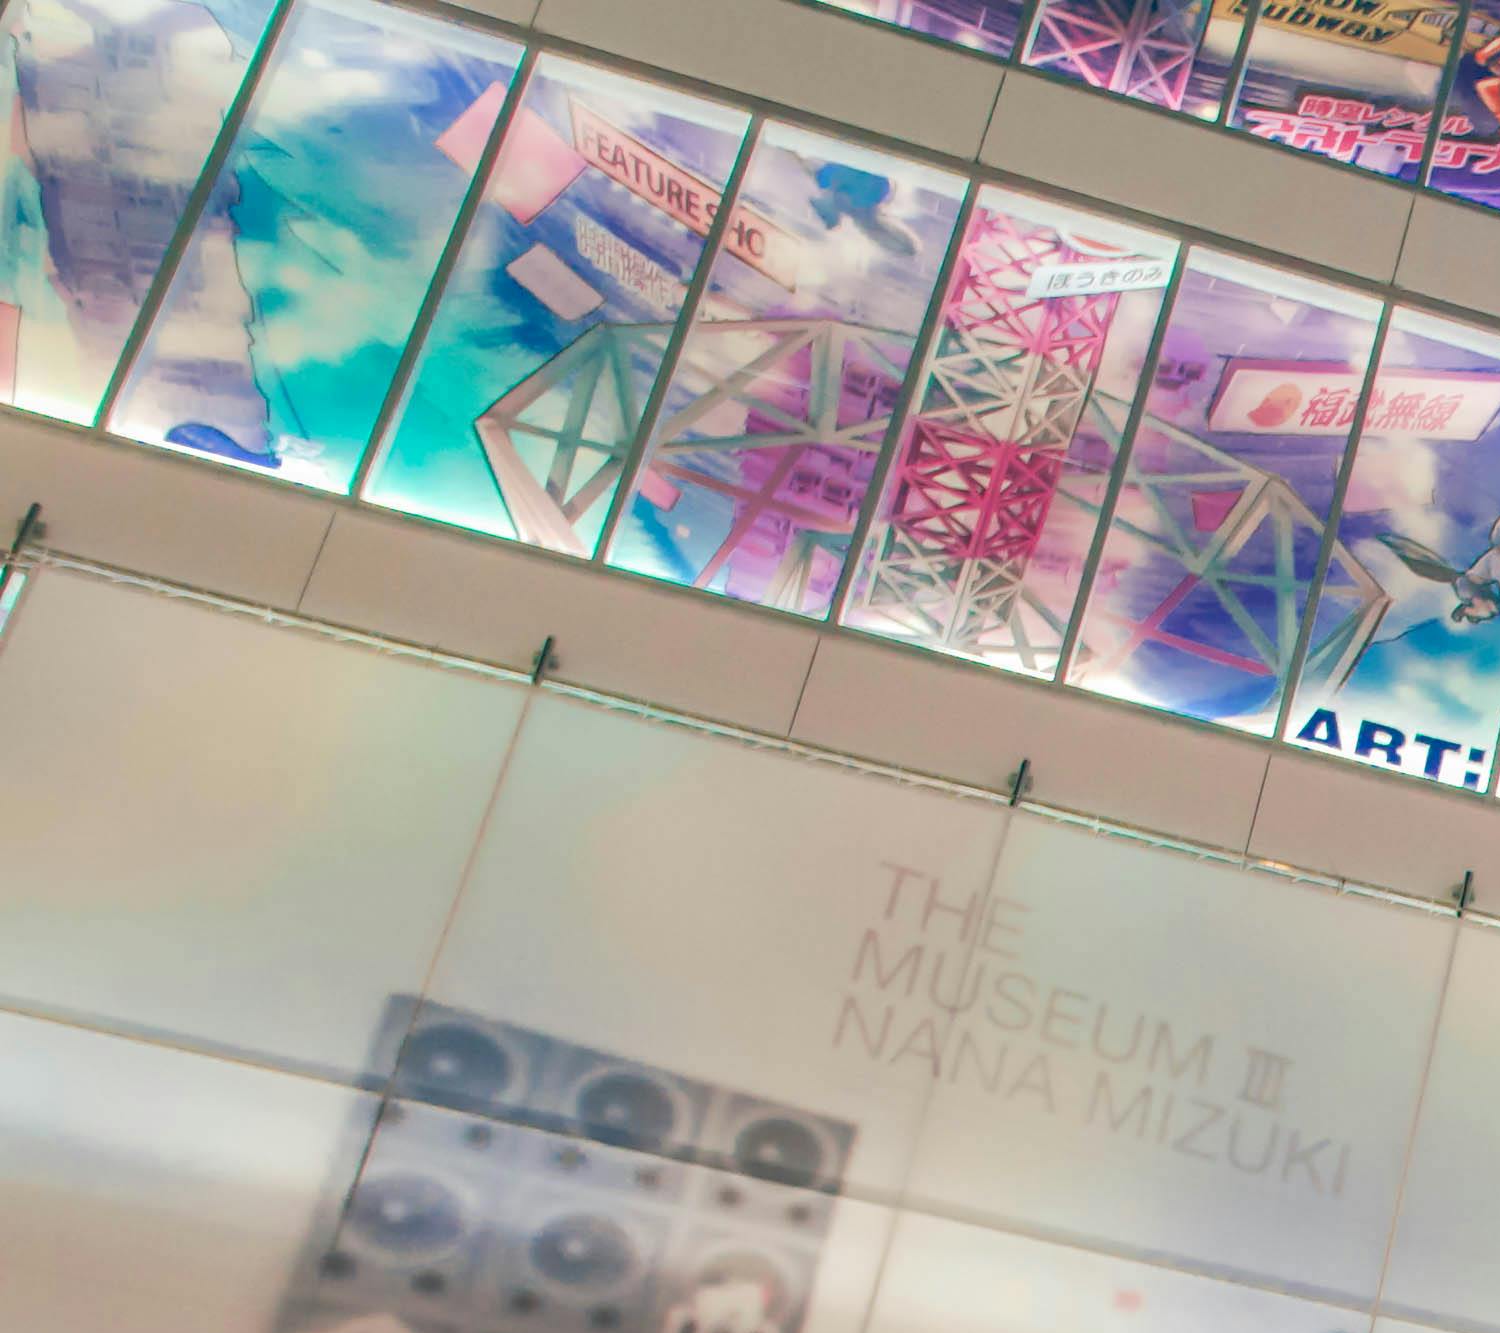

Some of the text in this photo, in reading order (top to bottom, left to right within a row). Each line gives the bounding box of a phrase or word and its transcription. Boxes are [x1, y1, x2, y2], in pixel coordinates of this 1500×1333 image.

[580, 119, 703, 222] FEATURE
[1297, 706, 1487, 793] ART:
[880, 860, 1031, 960] THE
[850, 926, 1217, 1088] MUSEUM
[832, 996, 1354, 1196] NANA MIZUKI
